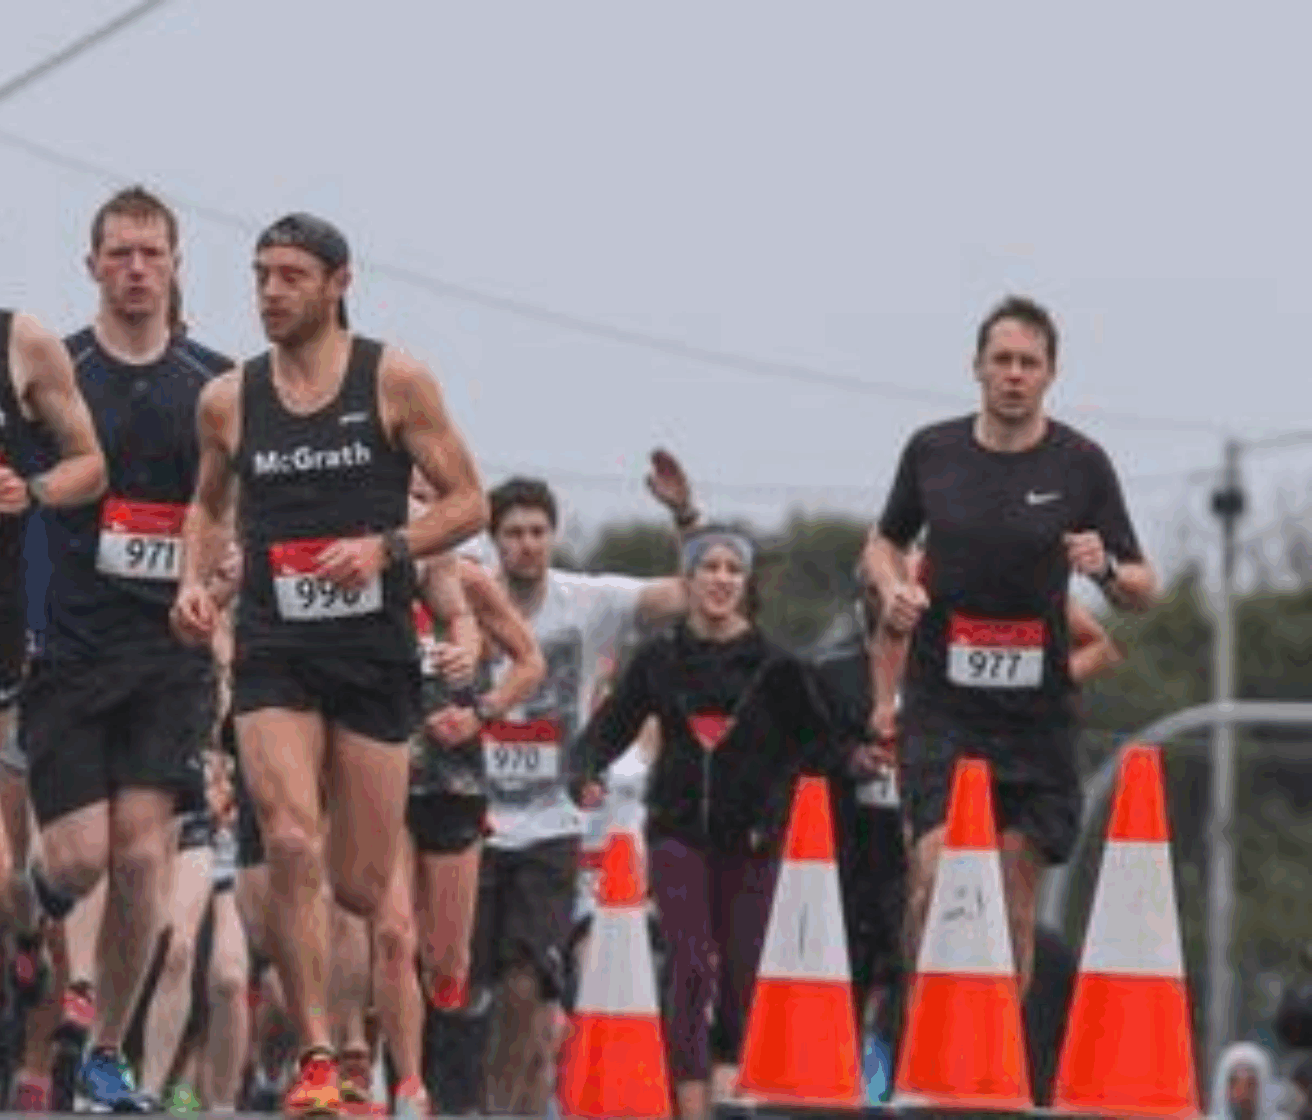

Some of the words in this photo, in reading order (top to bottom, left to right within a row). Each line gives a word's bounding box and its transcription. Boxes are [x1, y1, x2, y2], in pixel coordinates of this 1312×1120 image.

[255, 441, 372, 474] McGrath
[126, 538, 176, 570] 971
[968, 650, 1022, 680] 977
[493, 747, 539, 771] 970
